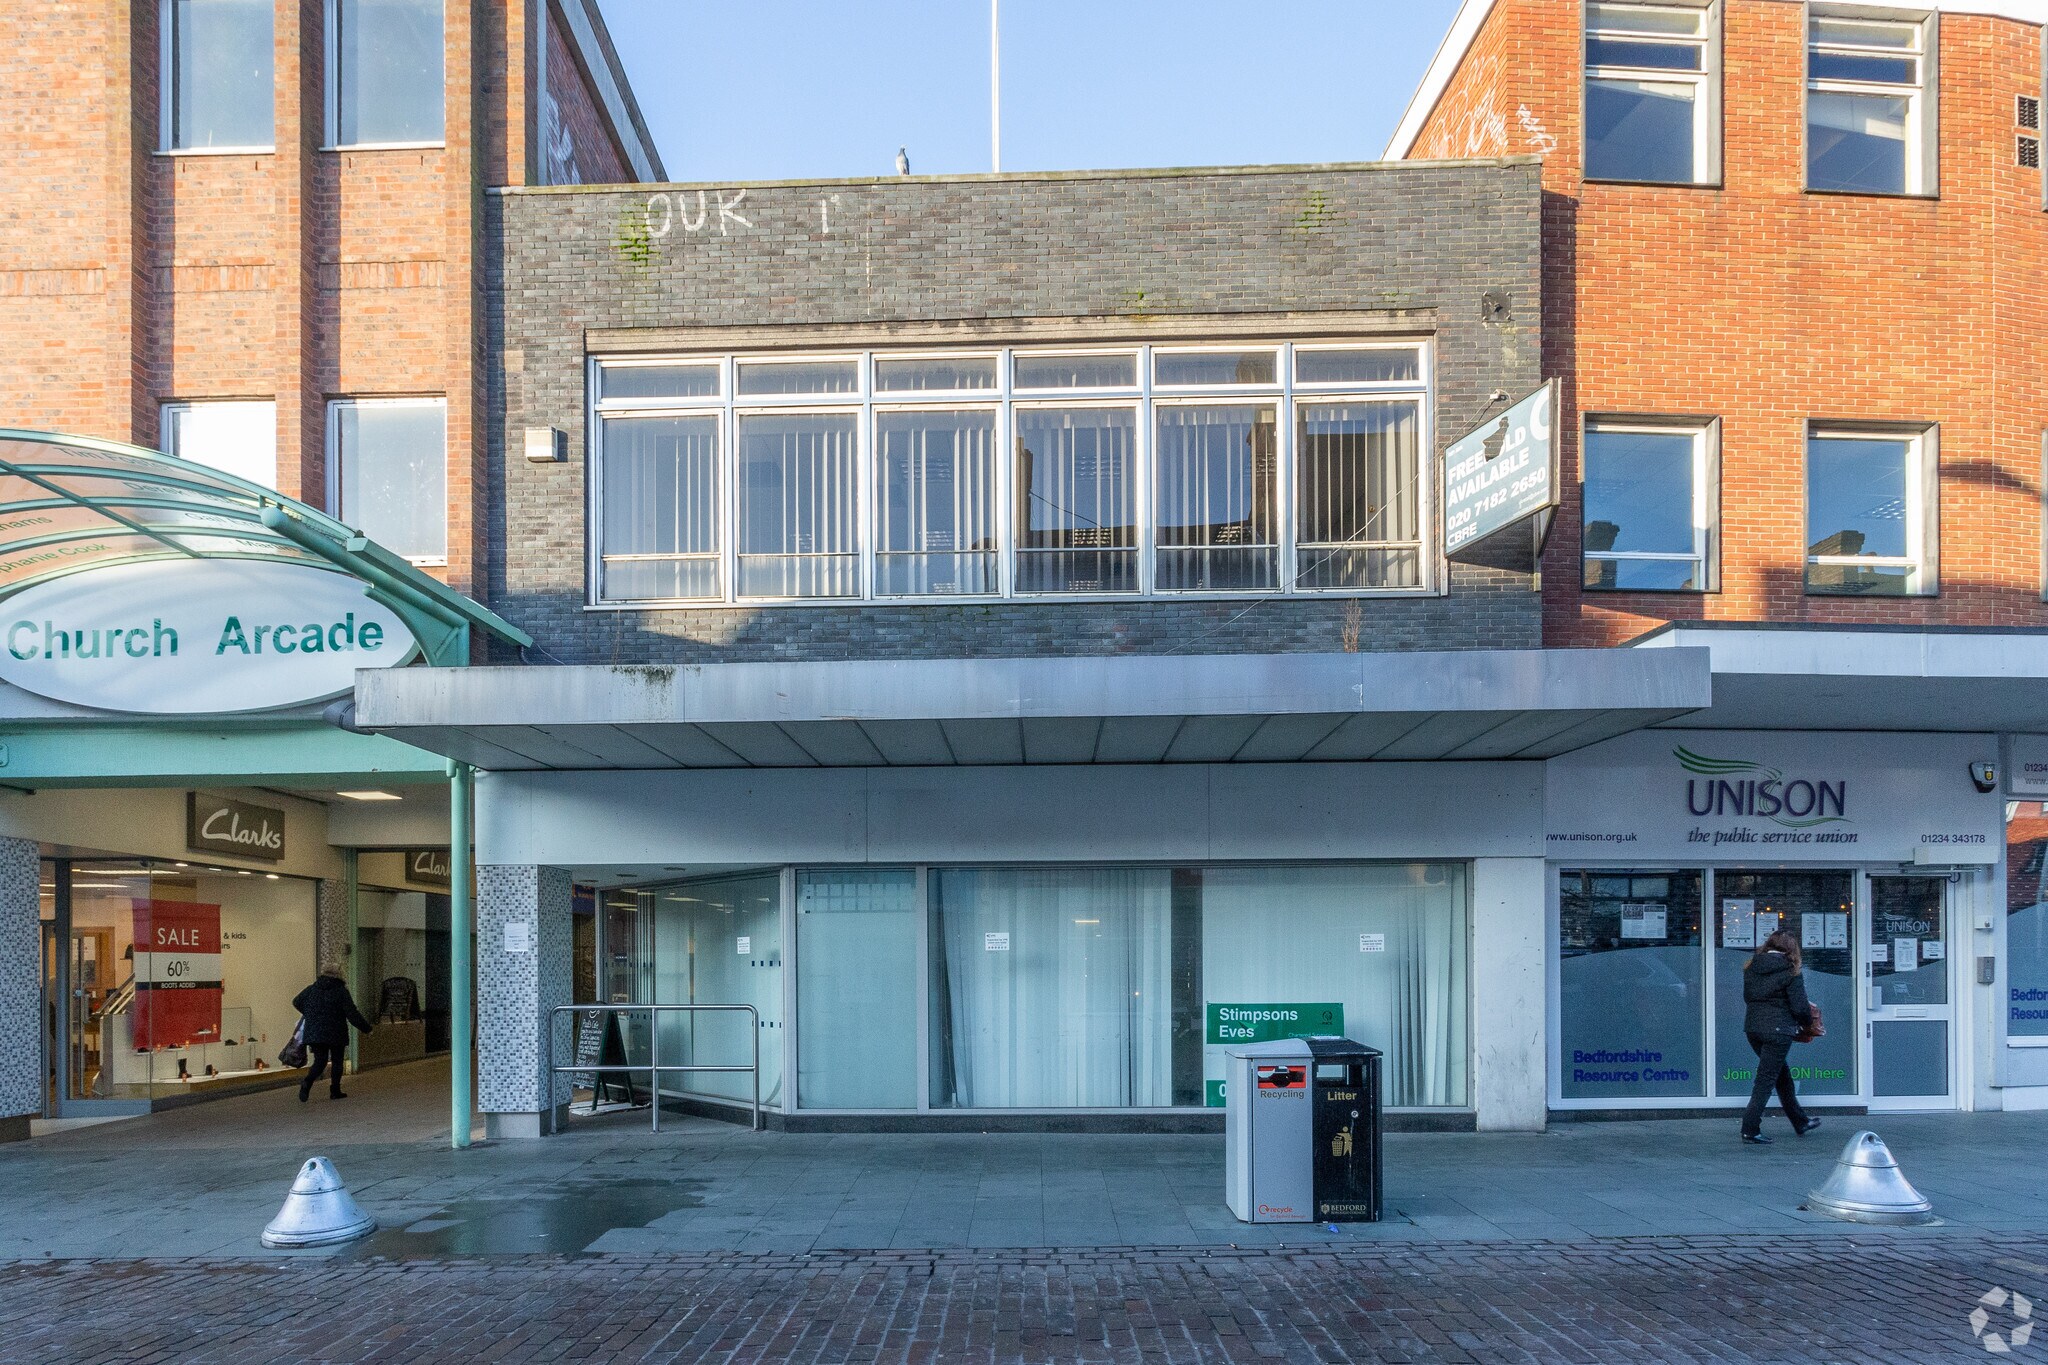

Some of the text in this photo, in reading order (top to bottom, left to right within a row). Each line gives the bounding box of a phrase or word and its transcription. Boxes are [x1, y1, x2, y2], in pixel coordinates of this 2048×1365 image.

[1448, 447, 1529, 508] AVAILABLE
[1448, 507, 1471, 531] 020
[1475, 488, 1507, 517] 7182
[1511, 467, 1546, 498] 2650
[1447, 522, 1478, 546] CBRE
[58, 543, 114, 557] Cook
[7, 612, 385, 661] Church Arcade
[1688, 778, 1846, 817] UNISON
[201, 808, 281, 849] Clarks
[1687, 827, 1858, 847] the public service union
[1921, 834, 1986, 844] 01234 343178
[1886, 920, 1931, 933] UNISON
[157, 927, 200, 946] SALE
[231, 932, 247, 940] kids
[167, 960, 190, 977] 60%
[1219, 1008, 1298, 1024] Stimpsons
[1219, 1025, 1255, 1038] Eves
[1573, 1049, 1662, 1064] Bedfordshire
[1573, 1067, 1690, 1082] Resource Centre
[1723, 1067, 1752, 1080] Join
[1814, 1067, 1845, 1079] here
[1260, 1090, 1304, 1100] Recycling
[1327, 1091, 1357, 1101] Litter
[1331, 1204, 1366, 1212] BEDFORD
